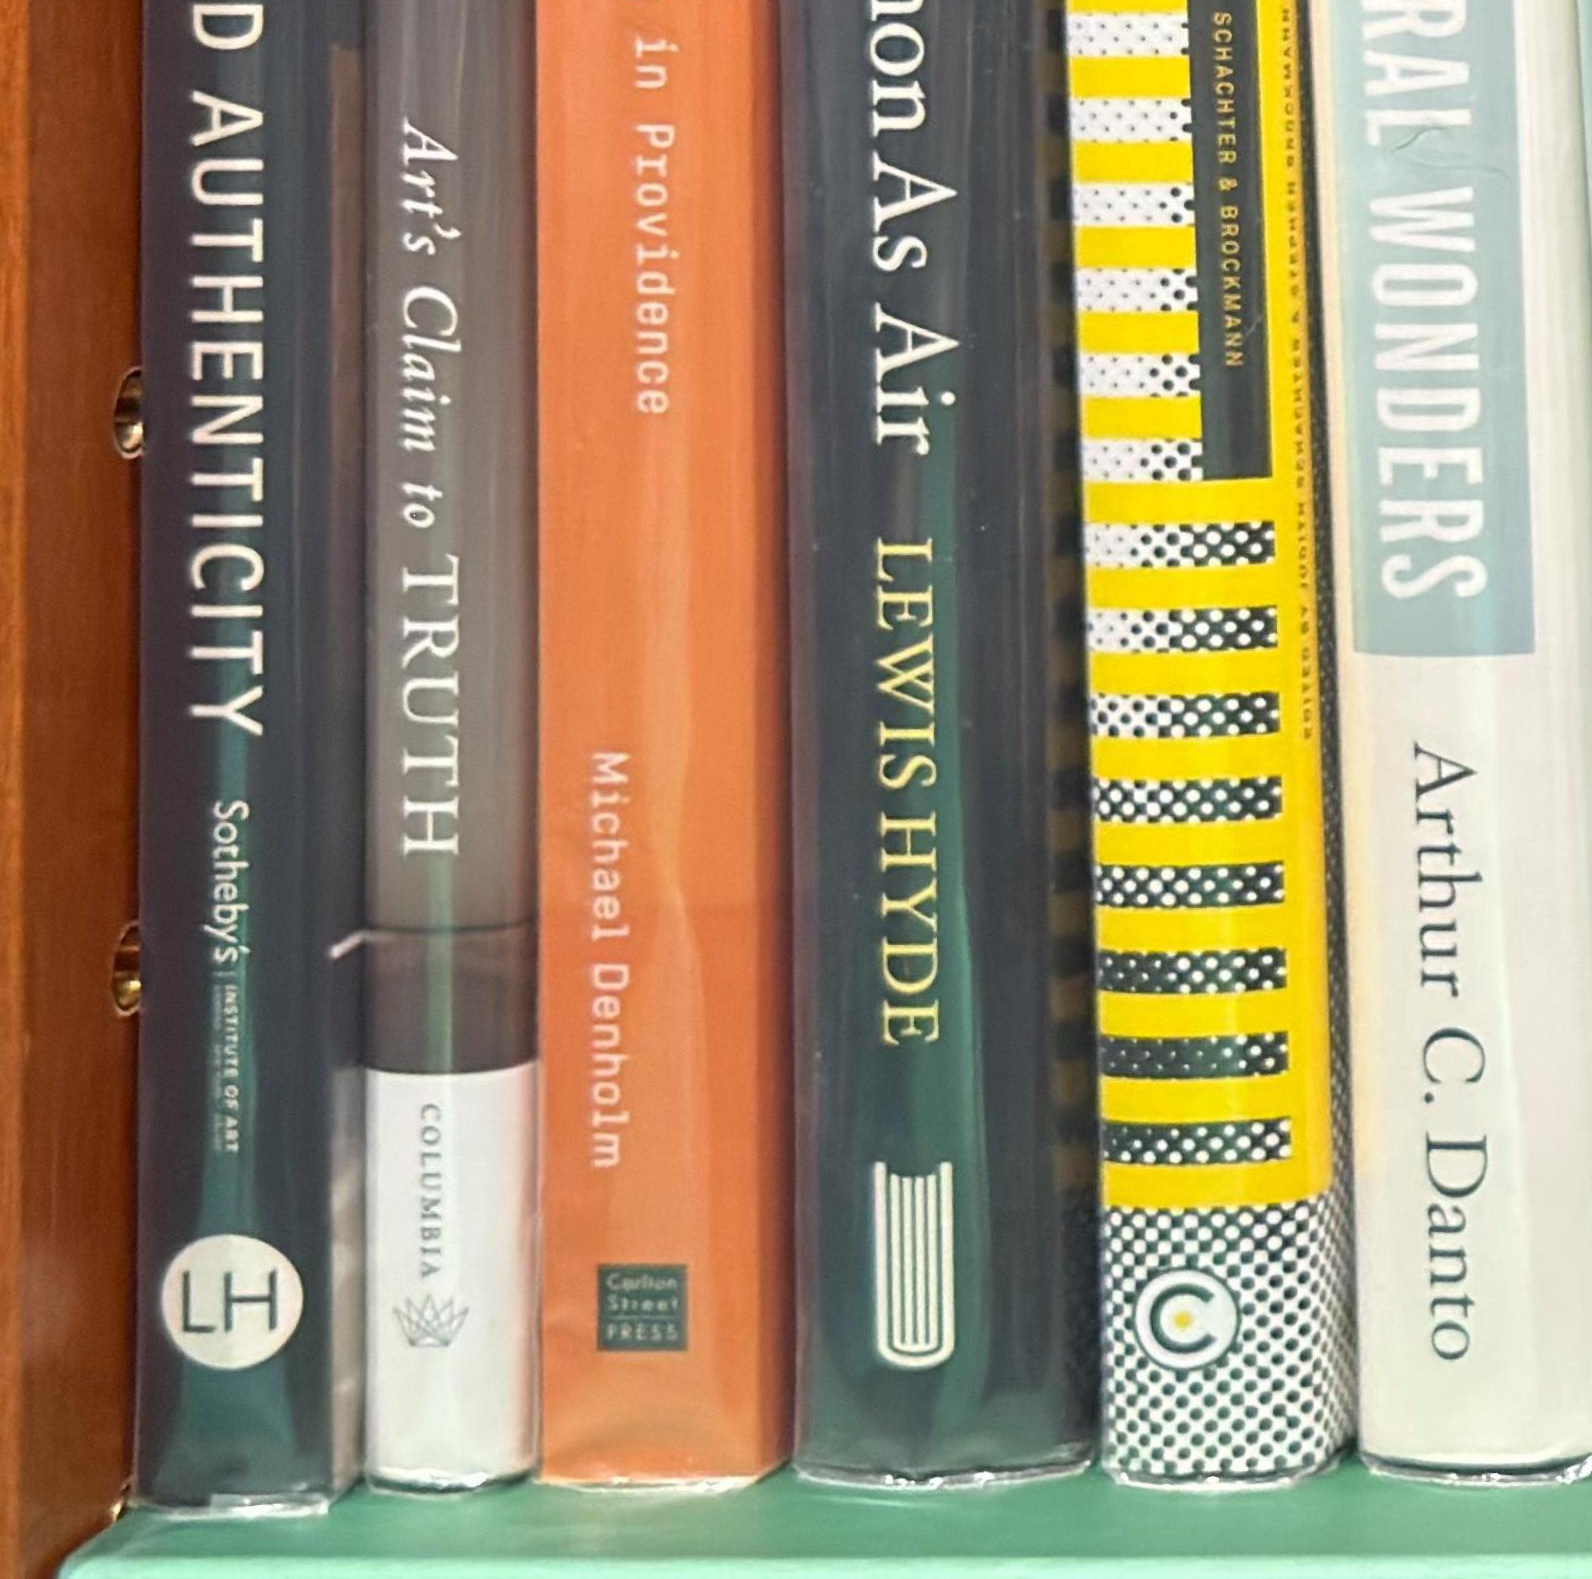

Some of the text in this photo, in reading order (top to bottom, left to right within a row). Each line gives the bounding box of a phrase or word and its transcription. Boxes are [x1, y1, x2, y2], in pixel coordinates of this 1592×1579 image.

[633, 43, 675, 94] in
[1211, 10, 1237, 165] SCHACHTER
[632, 122, 675, 415] Providence
[872, 149, 958, 272] As
[1219, 202, 1244, 368] BROCKMANN
[190, 90, 263, 735] AUTHENTICITY
[401, 119, 461, 858] Art's Claim to TRUTH
[875, 303, 958, 456] Air
[1370, 186, 1489, 601] WONDERS
[204, 799, 250, 964] Sotheby's
[875, 537, 940, 1047] LEWIS HYDE
[592, 750, 628, 1169] Michael Denholm
[1413, 741, 1491, 1363] Arthur C. Danto
[419, 1102, 439, 1278] COLUMBIA
